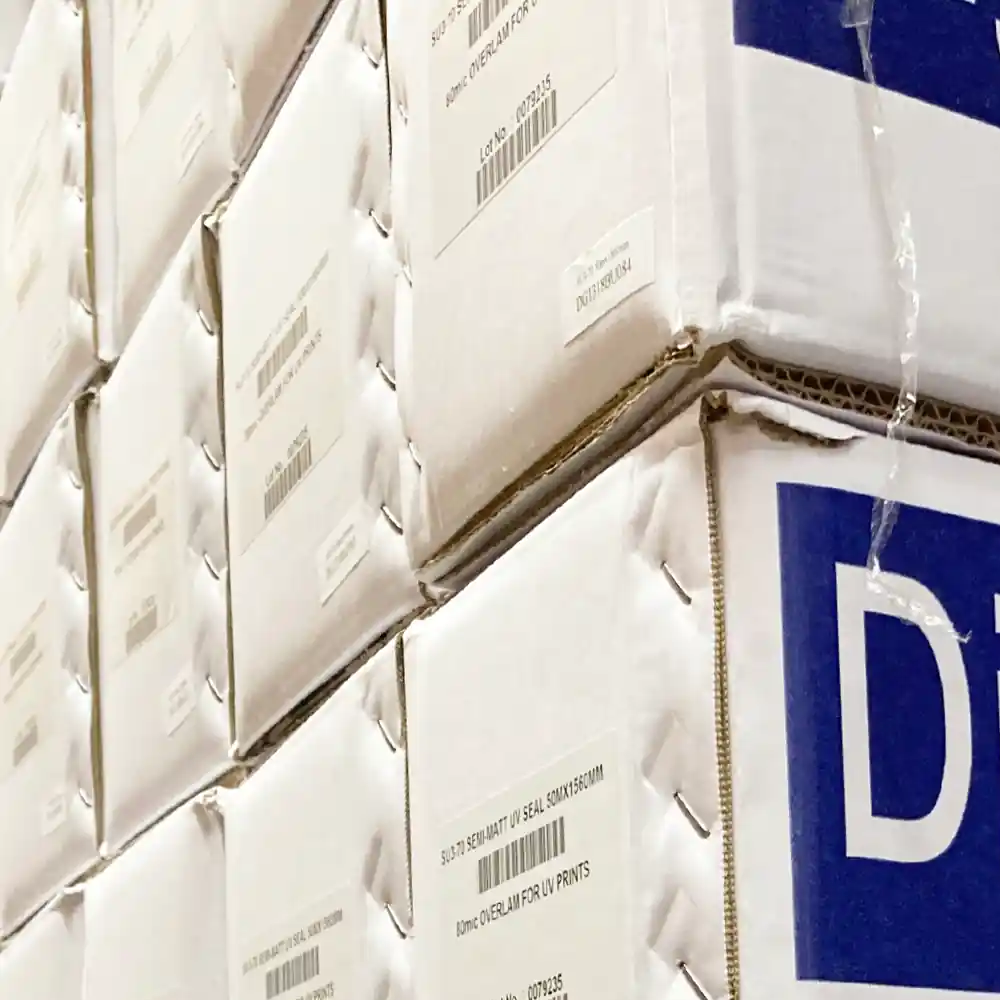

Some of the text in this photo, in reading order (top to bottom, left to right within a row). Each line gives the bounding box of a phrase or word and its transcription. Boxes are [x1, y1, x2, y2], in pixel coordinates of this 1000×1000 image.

[469, 20, 511, 80] OVERLAM
[511, 0, 529, 31] FOR
[480, 139, 493, 163] Lot
[516, 73, 552, 121] 0079235
[440, 763, 604, 866] SU3-70 SEMI-MATT UV SEAL 50MX1560MM
[456, 860, 591, 938] 80mic OVERLAM FOR UV PRINTS
